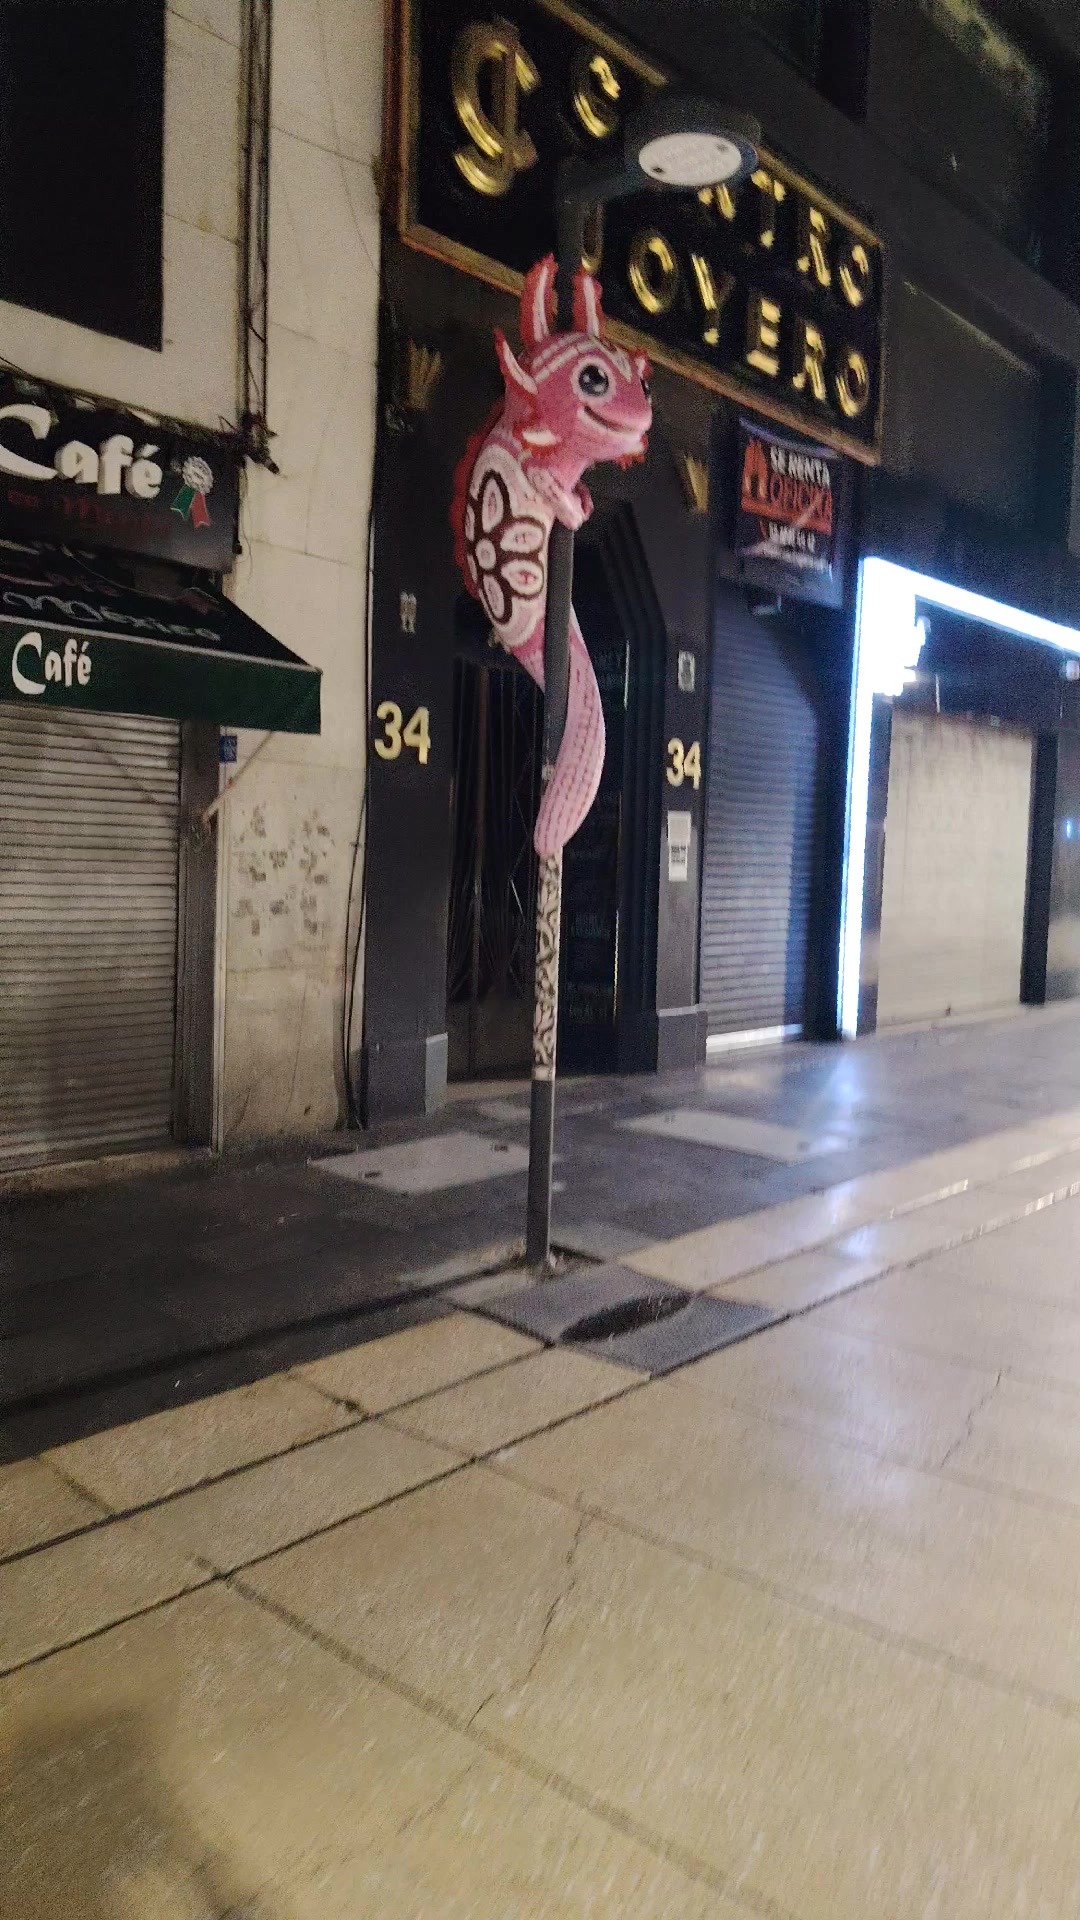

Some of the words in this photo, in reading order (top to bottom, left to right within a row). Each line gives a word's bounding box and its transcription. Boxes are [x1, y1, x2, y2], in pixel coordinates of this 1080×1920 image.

[0, 403, 162, 499] Café
[11, 631, 91, 696] Café
[374, 700, 430, 765] 34
[666, 738, 701, 790] 34
